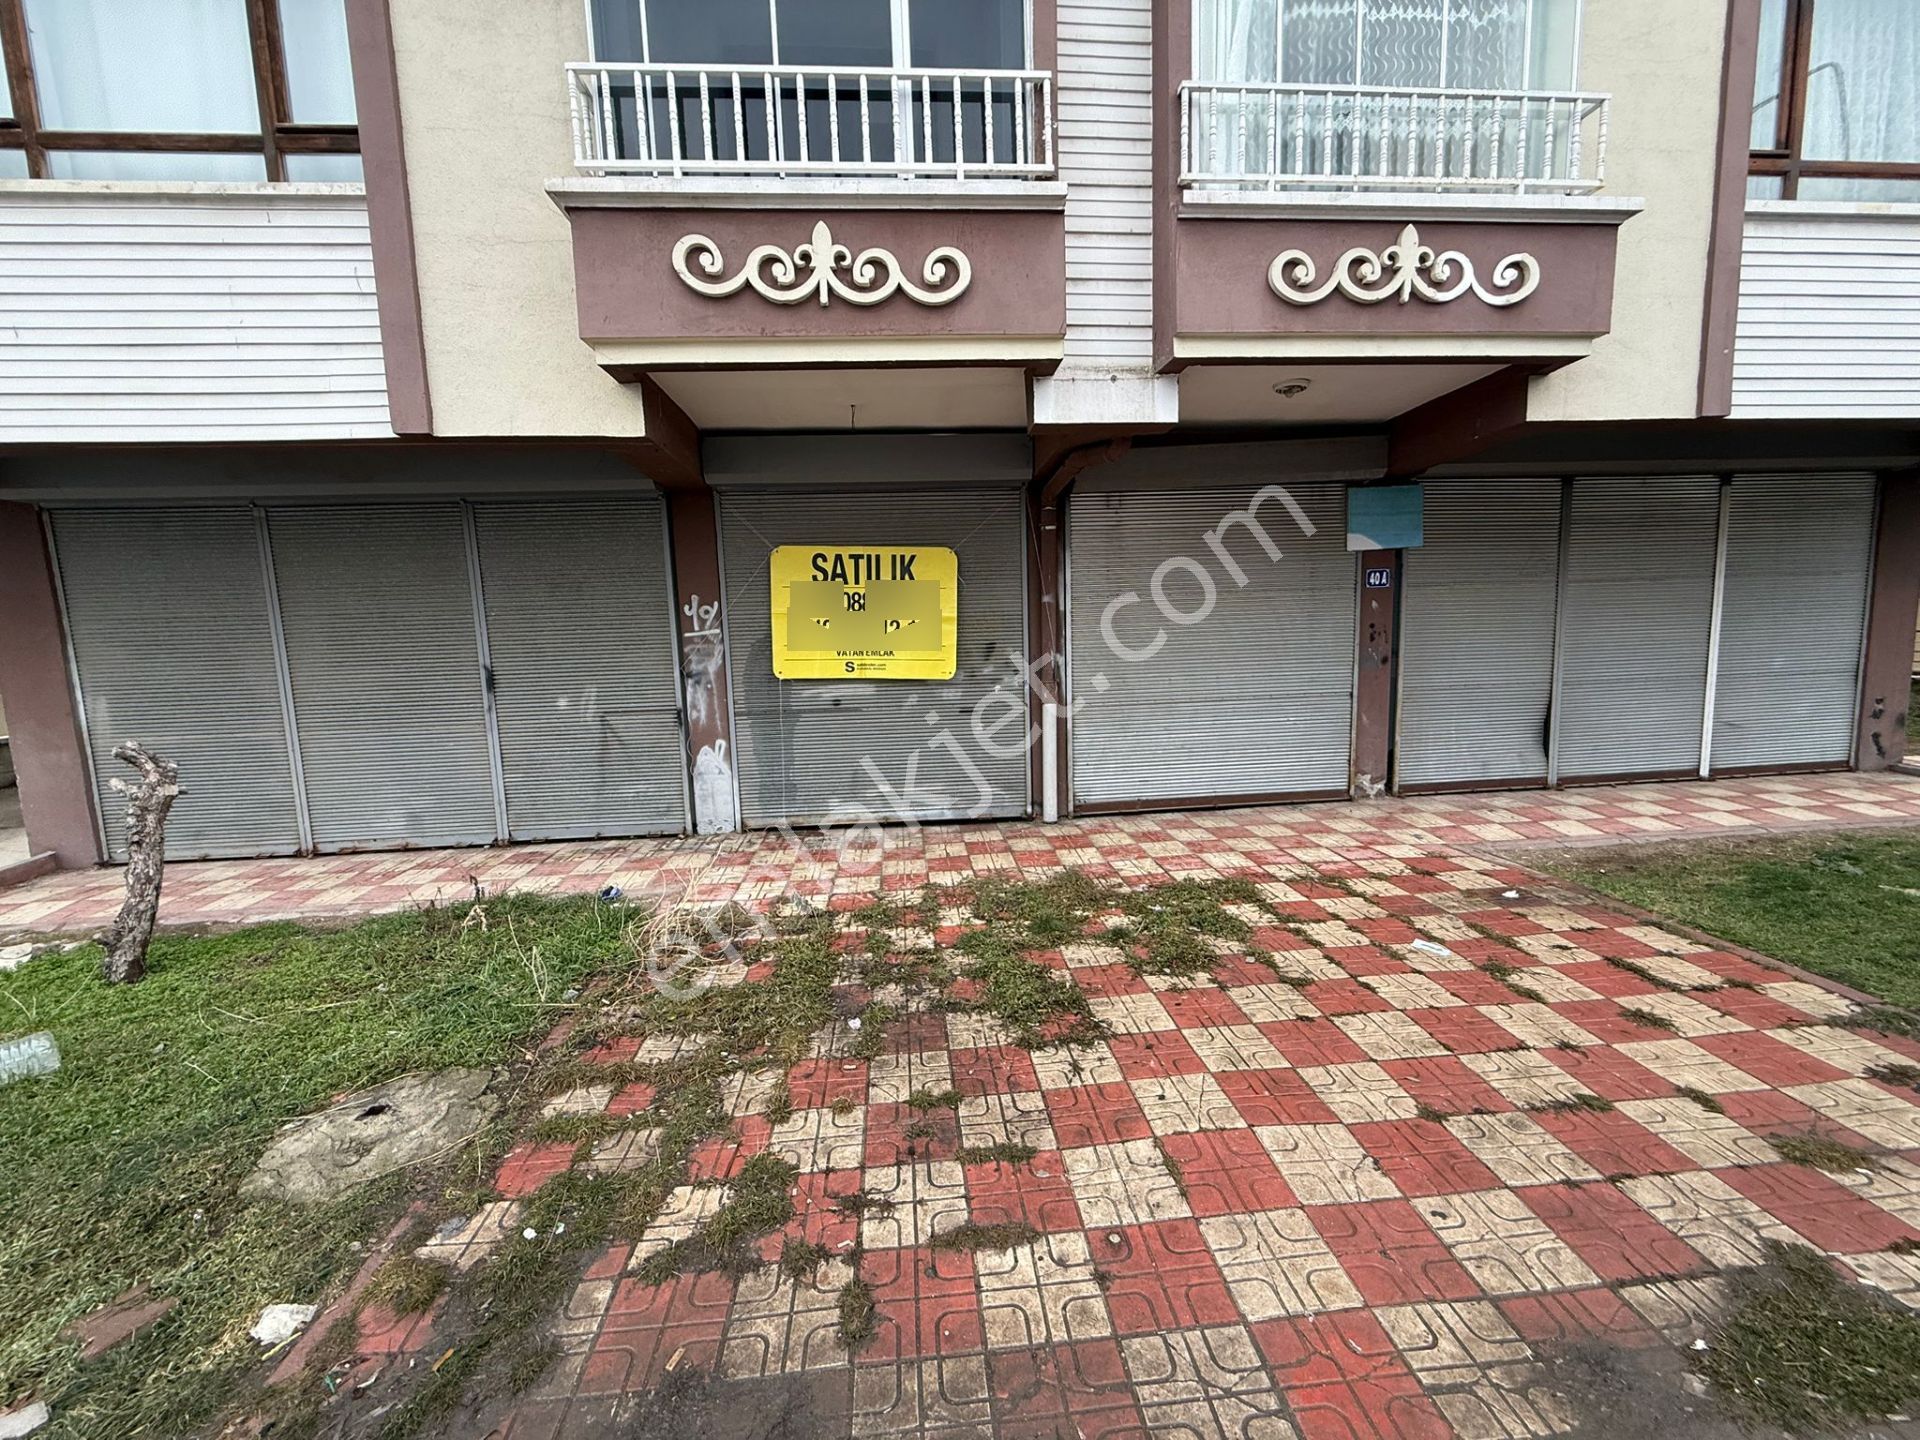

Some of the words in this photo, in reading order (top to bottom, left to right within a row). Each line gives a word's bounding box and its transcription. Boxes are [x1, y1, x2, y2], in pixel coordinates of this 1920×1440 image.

[1369, 571, 1380, 585] 40
[1381, 571, 1387, 584] A
[845, 661, 855, 673] S
